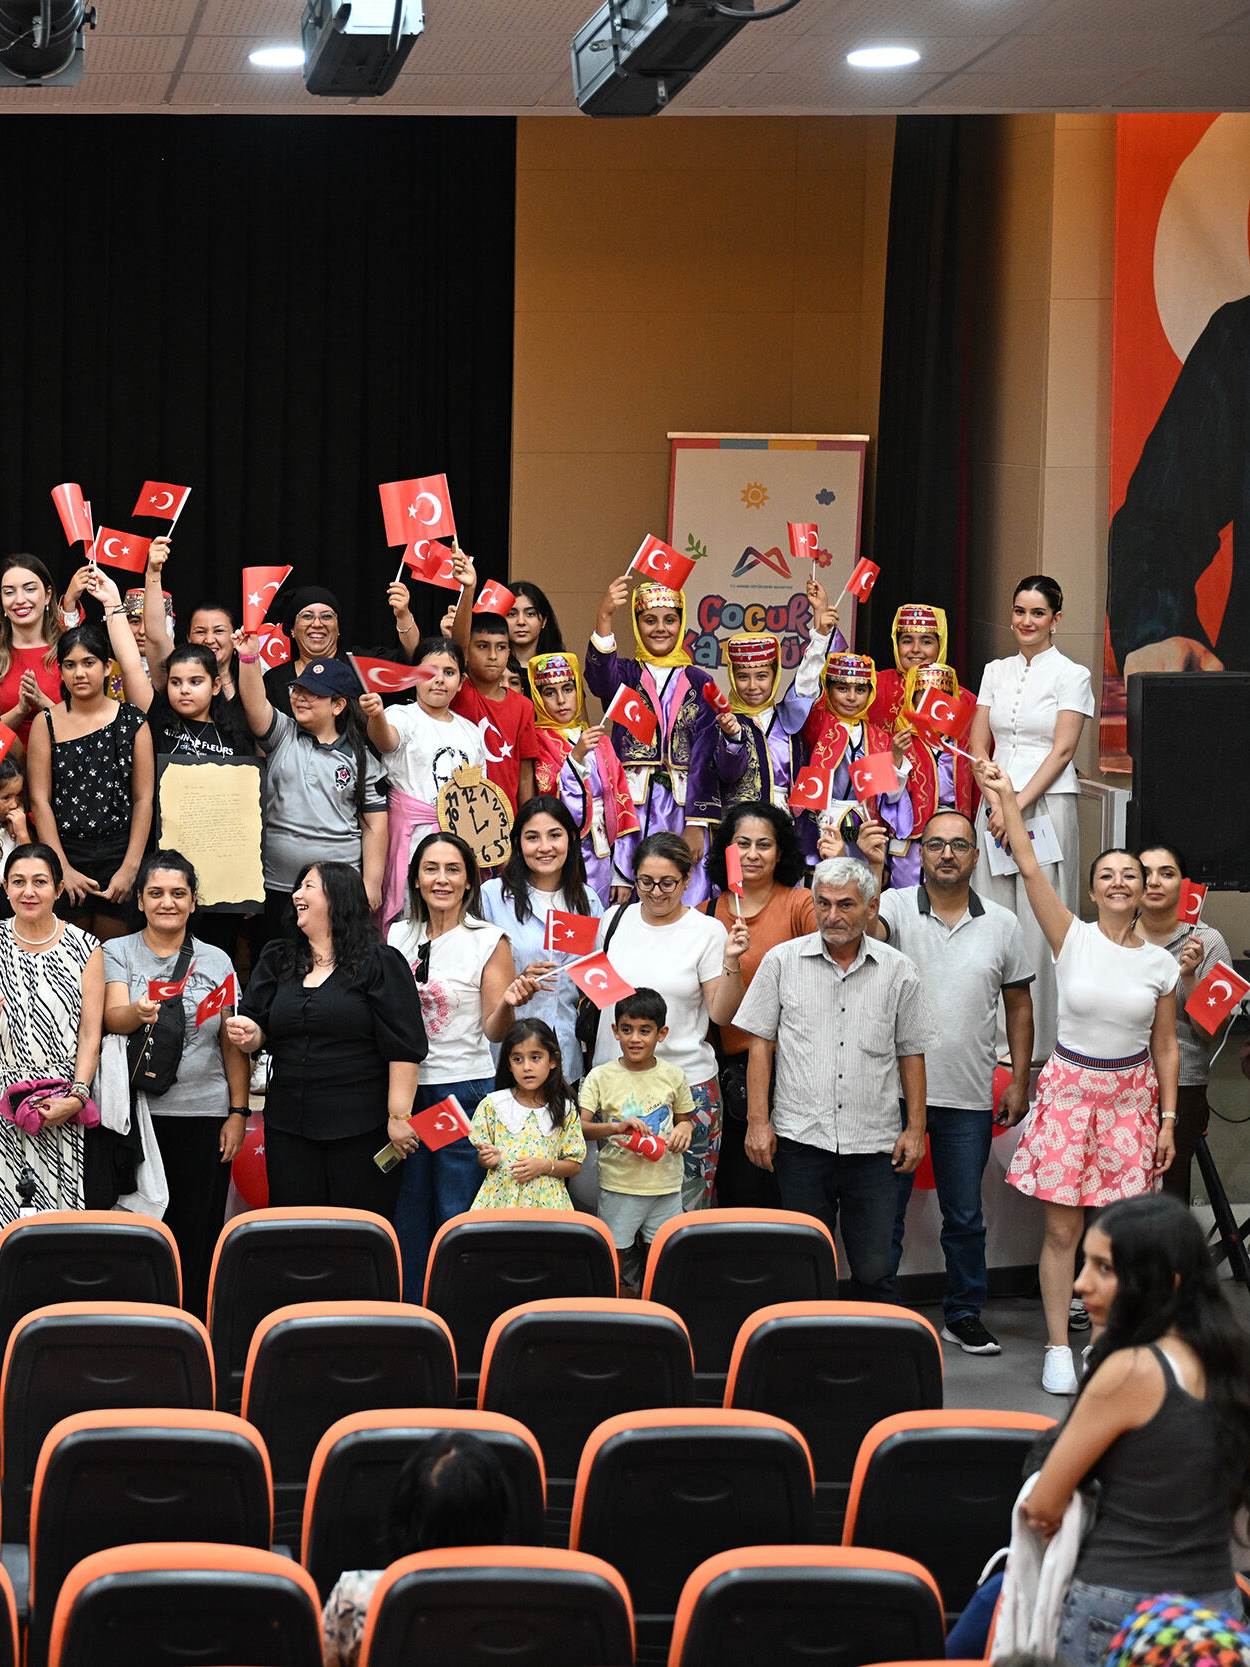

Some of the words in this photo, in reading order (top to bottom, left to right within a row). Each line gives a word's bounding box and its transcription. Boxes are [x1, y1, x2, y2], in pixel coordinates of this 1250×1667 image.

[445, 791, 459, 807] 11
[462, 788, 477, 804] 12
[480, 788, 489, 803] 1
[492, 798, 501, 811] 2
[445, 807, 459, 822] 10
[498, 812, 508, 827] 3
[500, 829, 509, 844] 4
[481, 845, 491, 862] 6
[493, 840, 505, 857] 5
